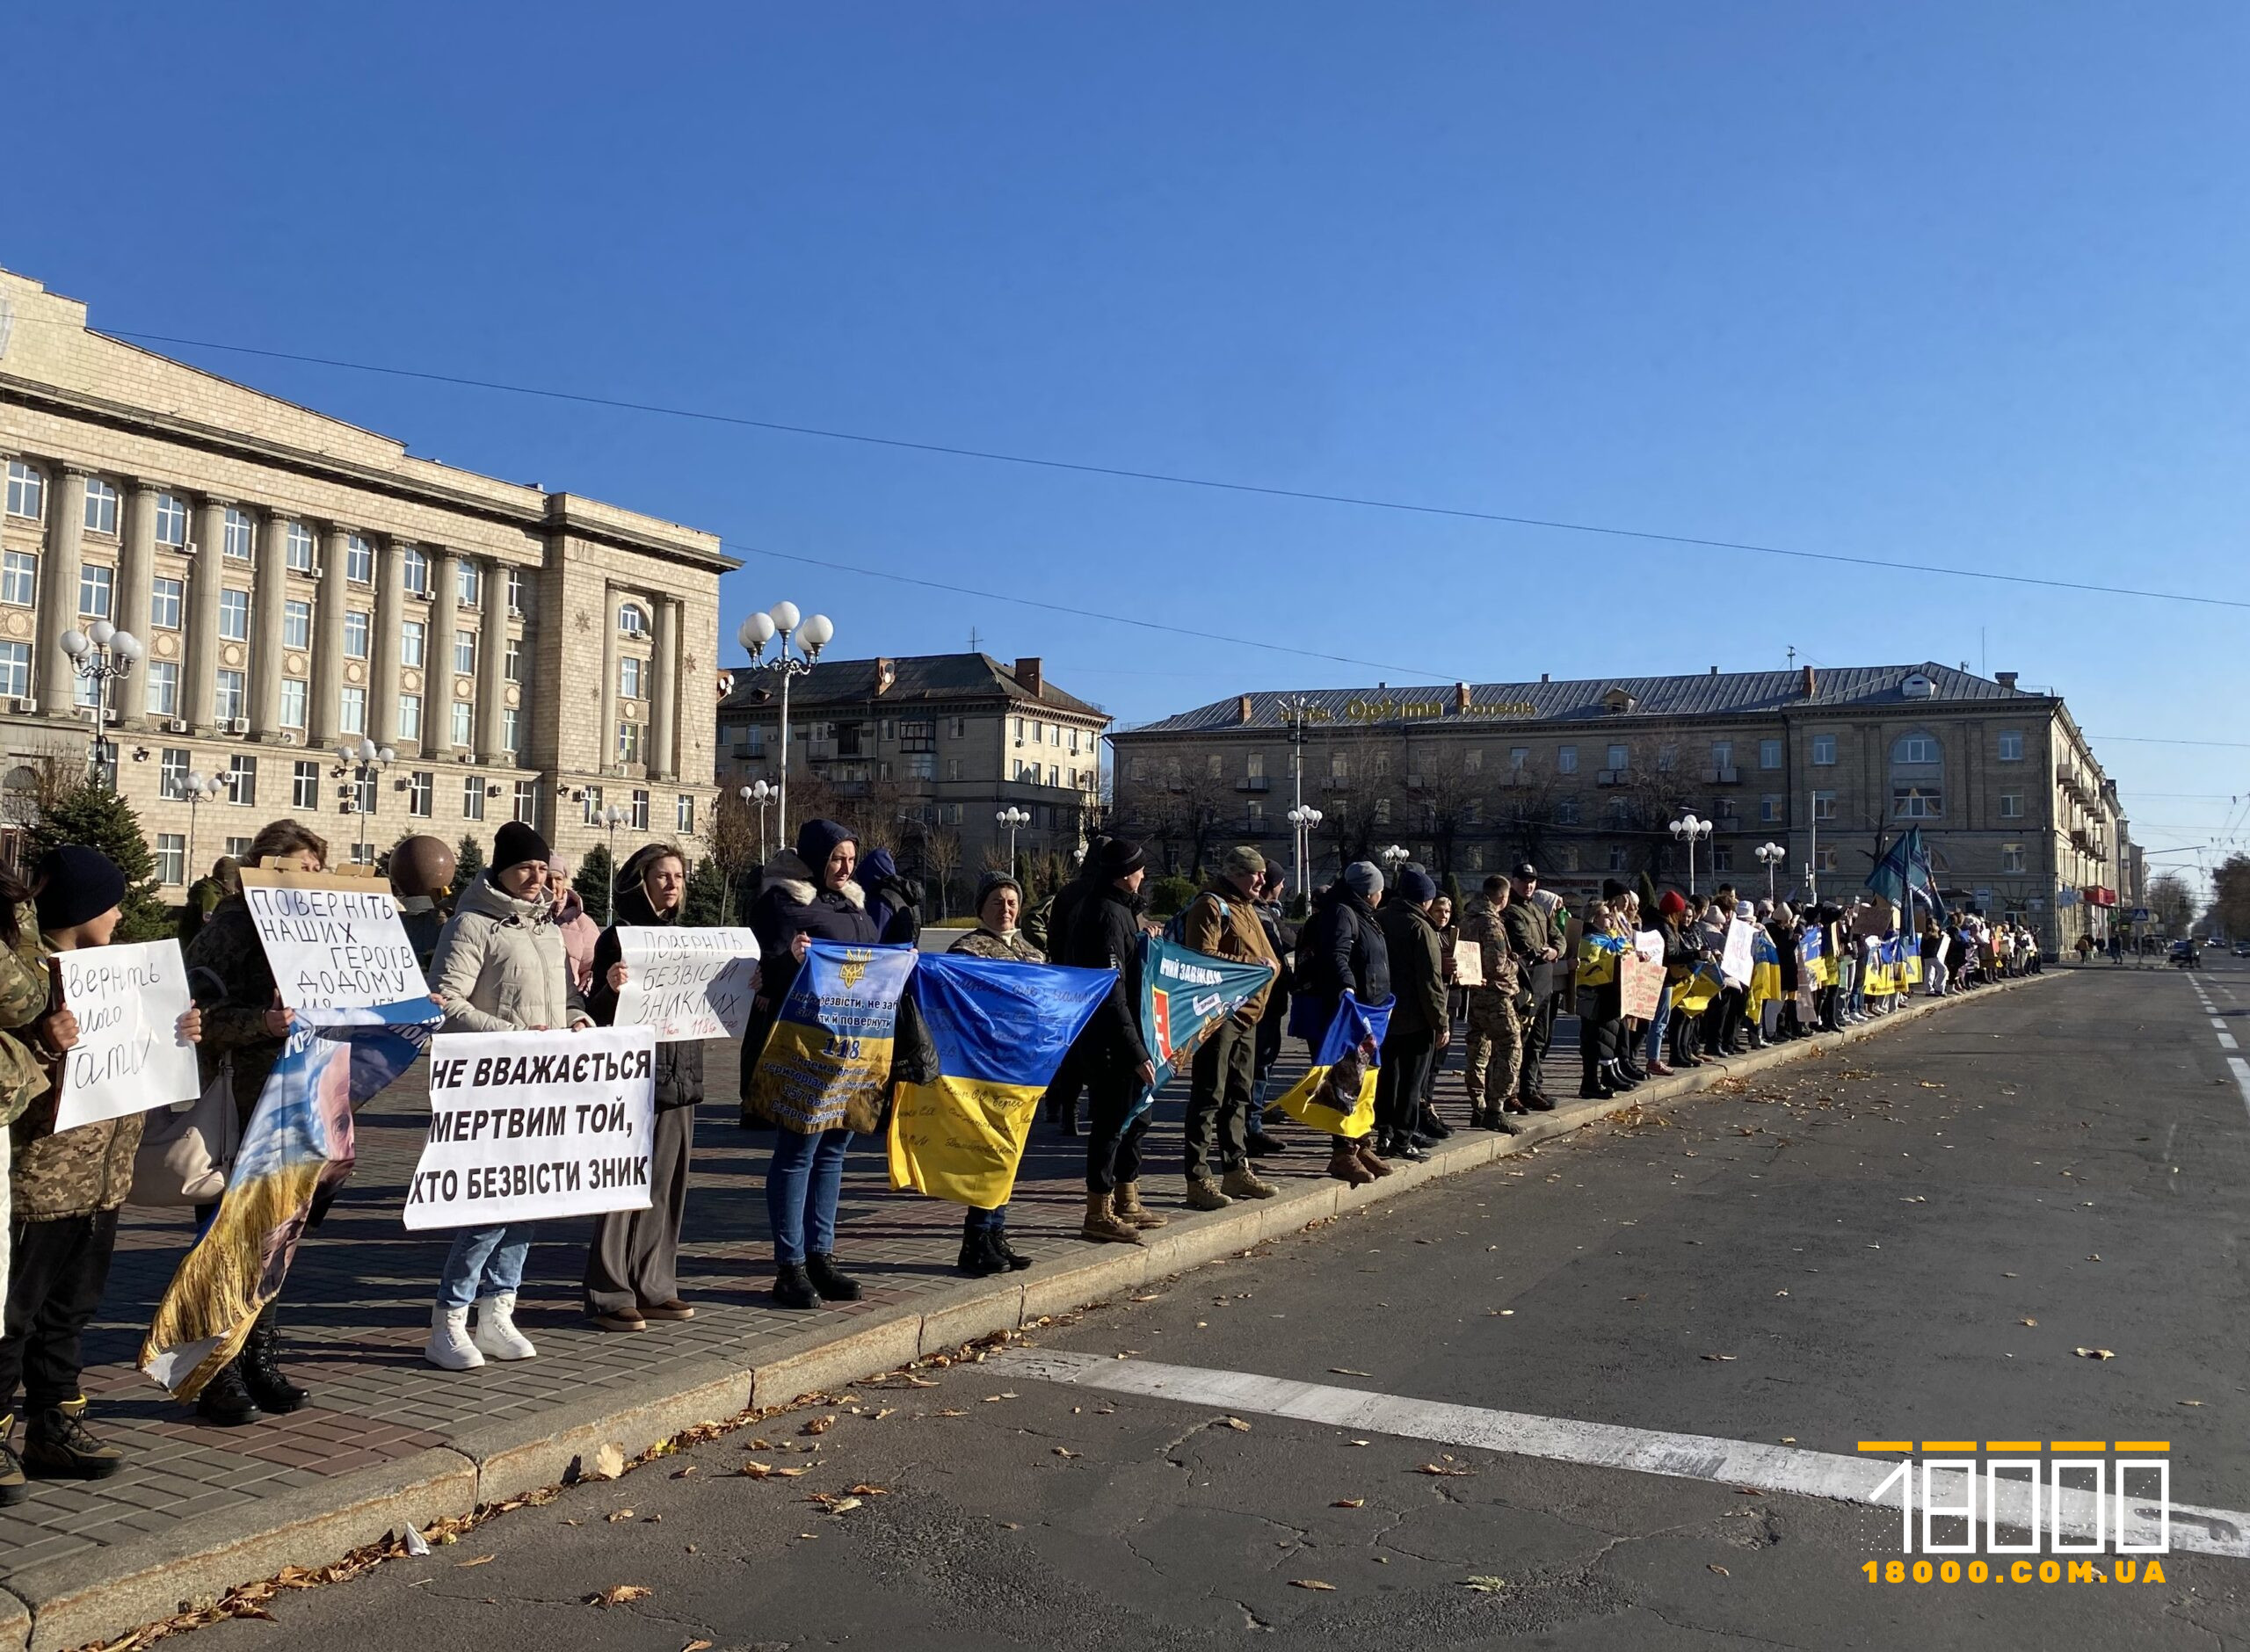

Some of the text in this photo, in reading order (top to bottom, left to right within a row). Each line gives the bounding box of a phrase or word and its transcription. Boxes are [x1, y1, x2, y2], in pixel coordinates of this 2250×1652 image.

[251, 889, 393, 920] ПОВЕРНІТЬ
[260, 919, 357, 944] НАШИХ
[330, 946, 414, 970] ГЕРОЇВ
[643, 931, 743, 964] ПОВЕРНІТЬ
[297, 970, 404, 995] ДОДОМУ
[642, 961, 740, 991] БЕЗВІСТИ
[634, 989, 740, 1025] ЗНИКЛИХ
[791, 1054, 834, 1073] окрема
[821, 1036, 860, 1061] 118
[431, 1049, 651, 1090] НЕ ВВАЖАЄТЬСЯ
[430, 1095, 632, 1142] МЕРТВИМ ТОЙ,
[409, 1156, 648, 1205] ХТО БЕЗВІСТИ ЗНИК
